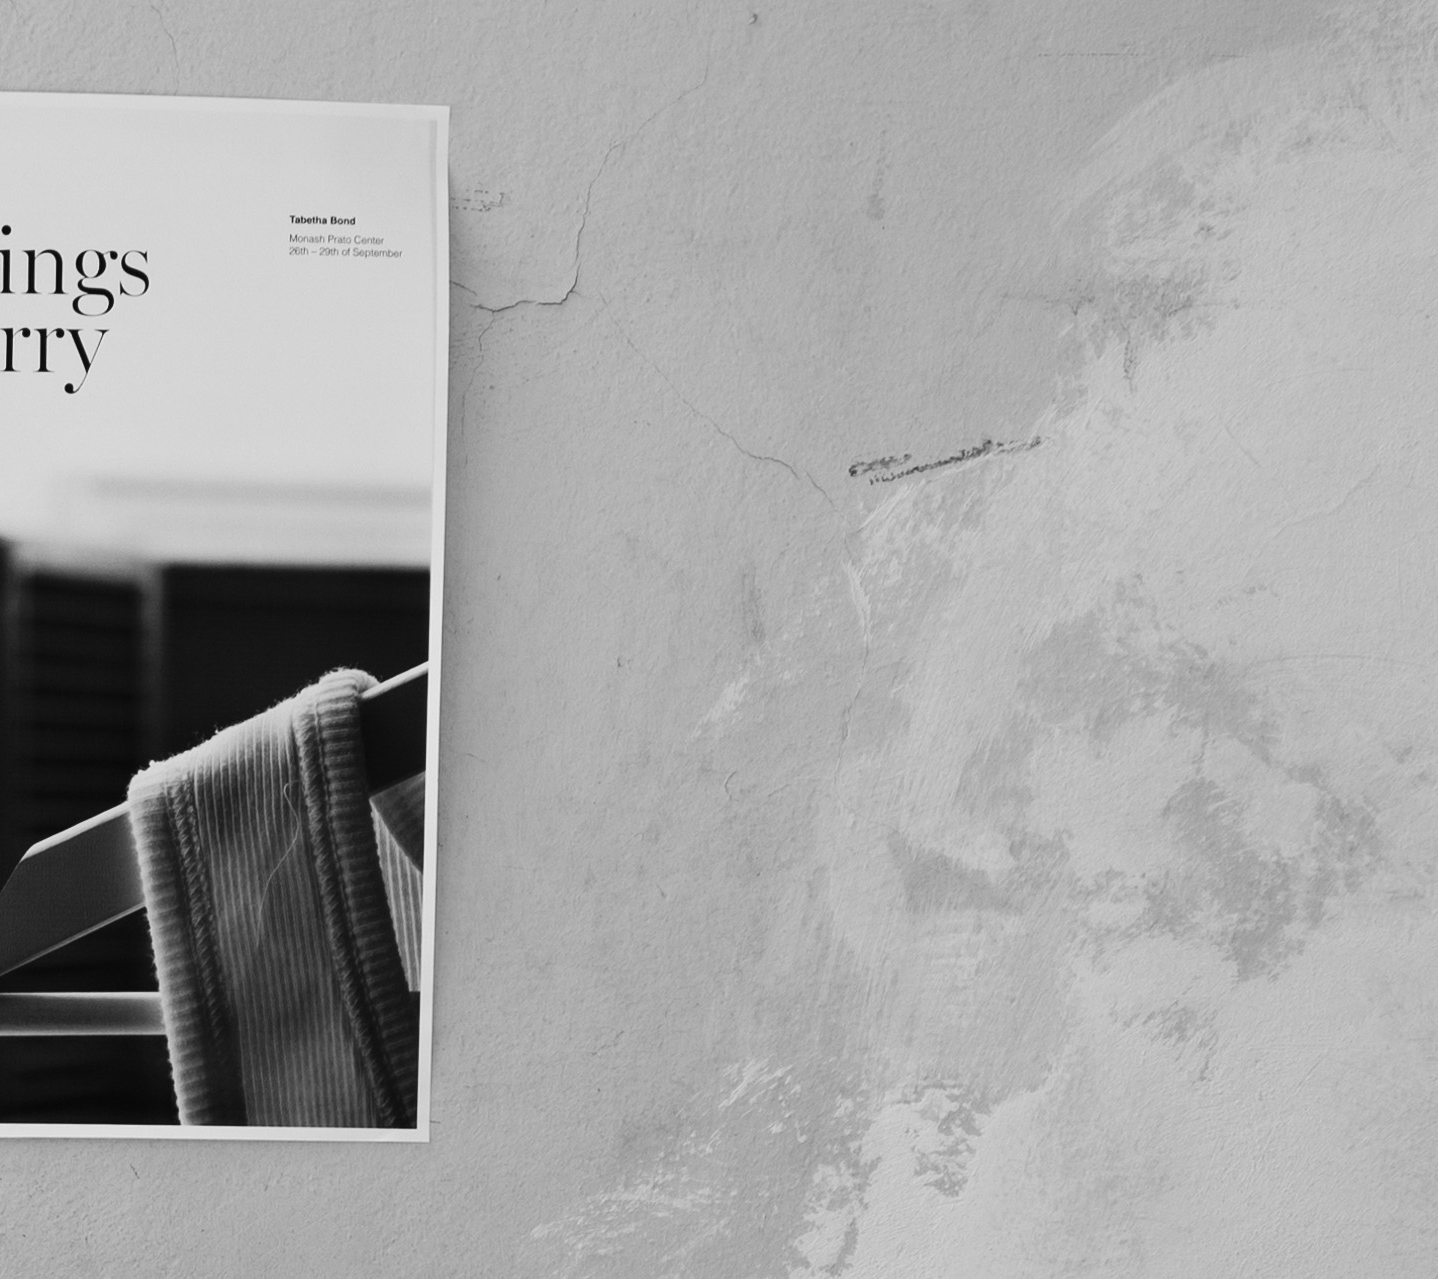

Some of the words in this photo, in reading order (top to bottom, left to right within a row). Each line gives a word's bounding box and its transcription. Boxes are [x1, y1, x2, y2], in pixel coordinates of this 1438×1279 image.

[289, 215, 328, 225] Tabetha
[330, 215, 356, 226] Bond
[289, 233, 325, 243] Monash
[327, 234, 352, 244] Prato
[353, 235, 385, 245] Center
[288, 246, 309, 256] 26th
[319, 247, 339, 256] 29th
[341, 248, 351, 256] of
[352, 248, 403, 258] September
